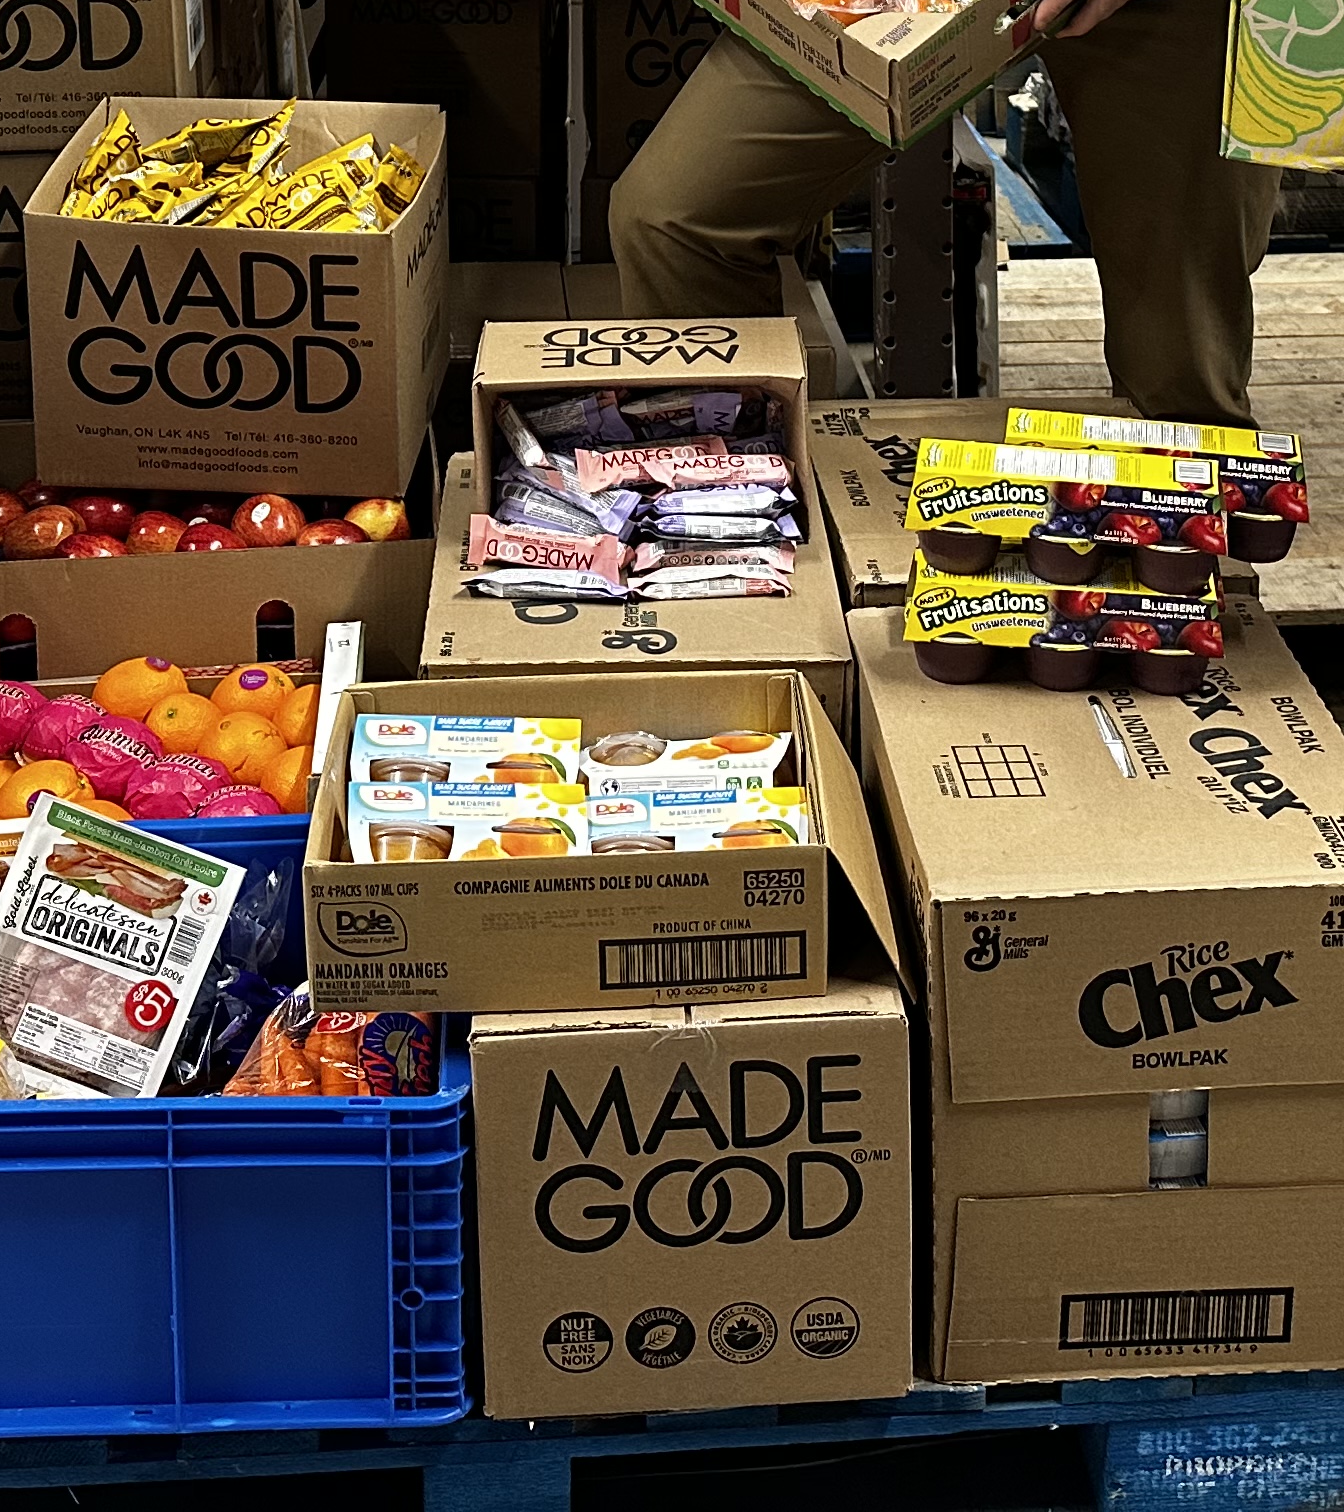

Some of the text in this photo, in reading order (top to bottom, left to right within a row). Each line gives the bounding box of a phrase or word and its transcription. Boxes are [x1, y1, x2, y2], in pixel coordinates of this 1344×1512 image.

[768, 23, 797, 52] GROWN
[906, 10, 978, 73] CUCUMBERS
[65, 240, 360, 331] MADE
[543, 325, 738, 347] GOOD
[541, 345, 739, 368] MADE
[68, 327, 362, 413] GOOD
[76, 423, 358, 446] Vaughan, ON L4K 4N5 416-360-8200
[137, 444, 298, 459] www.madegoodfoods.com
[139, 458, 298, 474] info@madegoodfoods.com
[919, 480, 950, 496] MOTT'S
[920, 482, 1046, 519] Fruitsations
[971, 508, 1044, 521] Unsweetened
[919, 589, 951, 606] MOTT'S
[921, 592, 1046, 629] Fruitsations
[972, 618, 1044, 632] Unsweetened
[378, 724, 416, 735] Dole
[1271, 696, 1325, 754] BOWLPAK
[374, 790, 413, 801] Dole
[454, 873, 710, 896] COMPAGNIE ALIMENTS DOLE DU CANADA
[745, 870, 803, 889] 65250
[311, 886, 324, 898] SIX
[365, 885, 379, 896] 107
[382, 884, 395, 896] ML
[397, 883, 419, 895] CUPS
[744, 890, 805, 907] 04270
[1329, 895, 1344, 906] 100
[39, 887, 165, 939] delicatessen
[336, 910, 394, 932] Dole
[964, 910, 1006, 922] 96 20
[653, 918, 752, 934] PRODUCT OF CHINA
[32, 907, 161, 967] ORIGINALS
[1004, 935, 1049, 948] General
[1003, 947, 1029, 960] Mills
[1160, 940, 1230, 976] Rice
[315, 962, 449, 980] MANDARIN ORANGES
[325, 981, 348, 989] WATER
[387, 980, 410, 988] ADDED
[1132, 1049, 1228, 1069] BOWLPAK
[532, 1054, 862, 1161] MADE
[535, 1150, 863, 1253] GOOD
[561, 1318, 595, 1330] NUT
[806, 1311, 844, 1327] USDA
[561, 1329, 596, 1342] FREE
[801, 1329, 849, 1343] ORGANIC
[561, 1343, 596, 1355] SANS
[561, 1353, 596, 1366] NOIX
